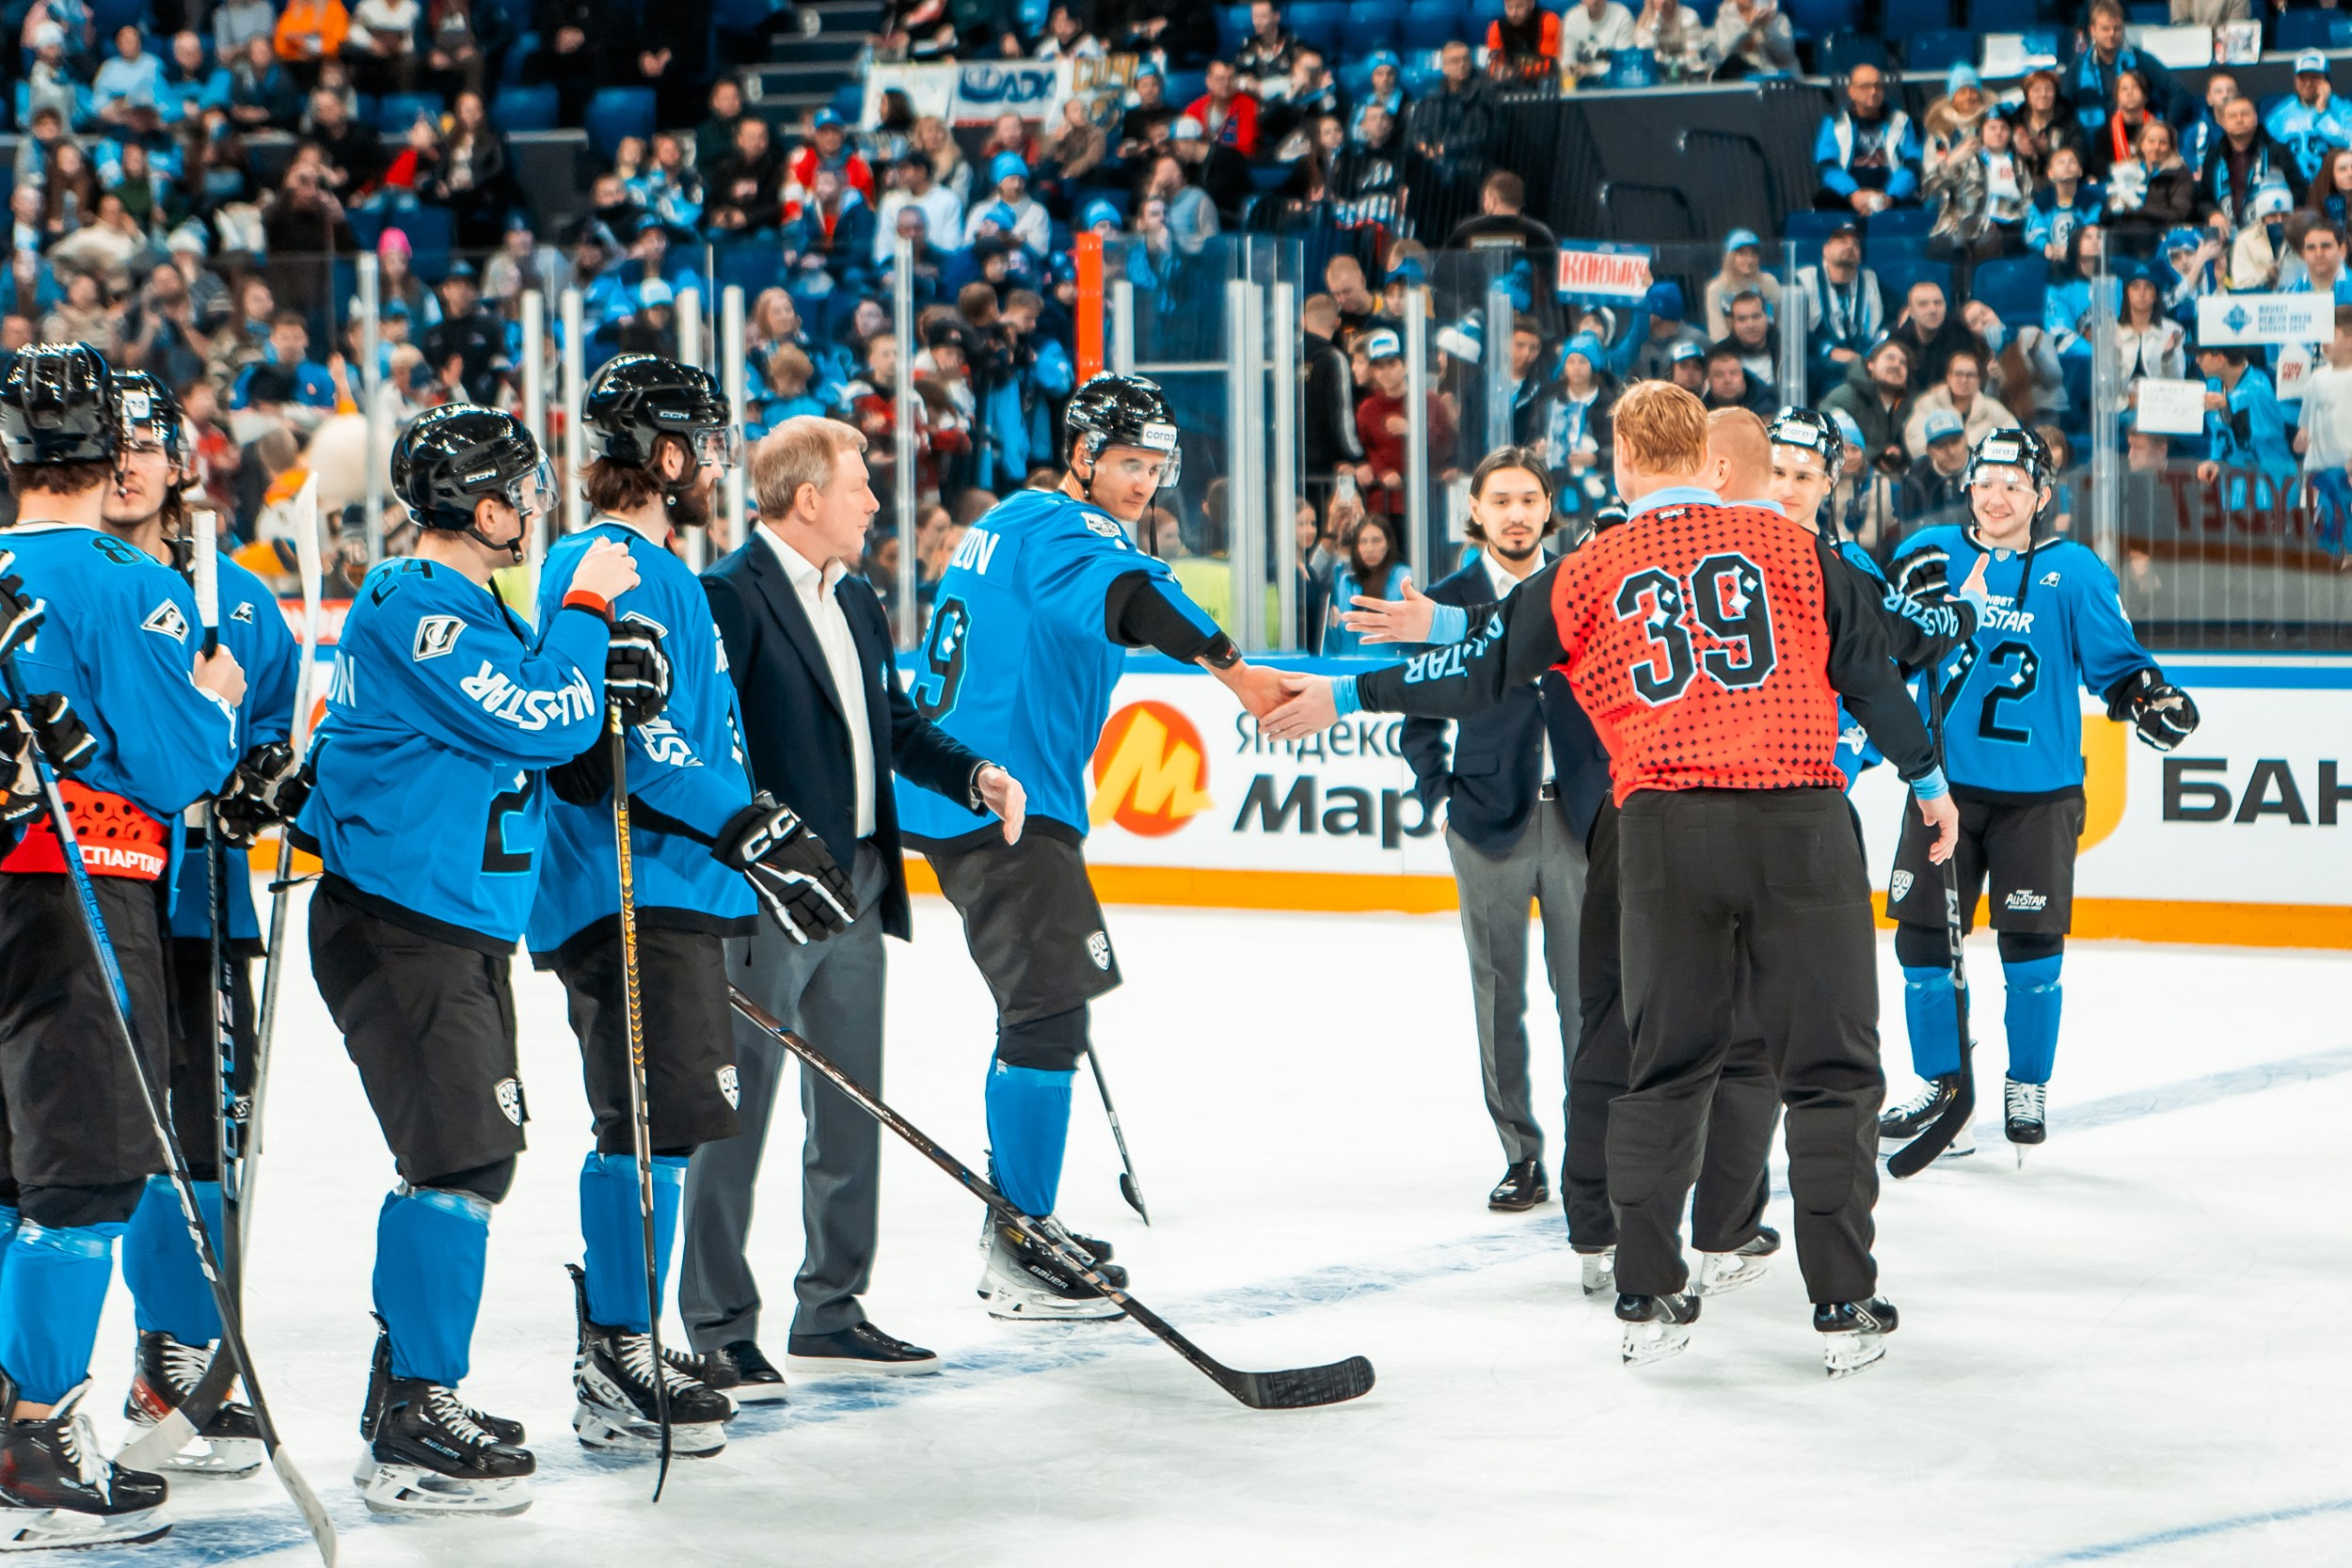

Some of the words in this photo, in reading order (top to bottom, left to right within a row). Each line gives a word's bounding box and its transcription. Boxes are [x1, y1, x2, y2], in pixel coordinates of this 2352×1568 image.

[659, 410, 691, 420] CCM
[465, 469, 498, 484] CCM
[1981, 605, 2036, 634] STAR
[1985, 594, 2016, 608] NBET
[1613, 550, 1778, 708] 39
[914, 594, 974, 724] 9
[740, 802, 803, 863] CC
[1232, 772, 1439, 850] Мар
[81, 844, 164, 878] СПАРТАК
[72, 858, 111, 945] RIBCOR
[1945, 887, 1966, 990] CCM
[421, 1437, 461, 1460] BAUER
